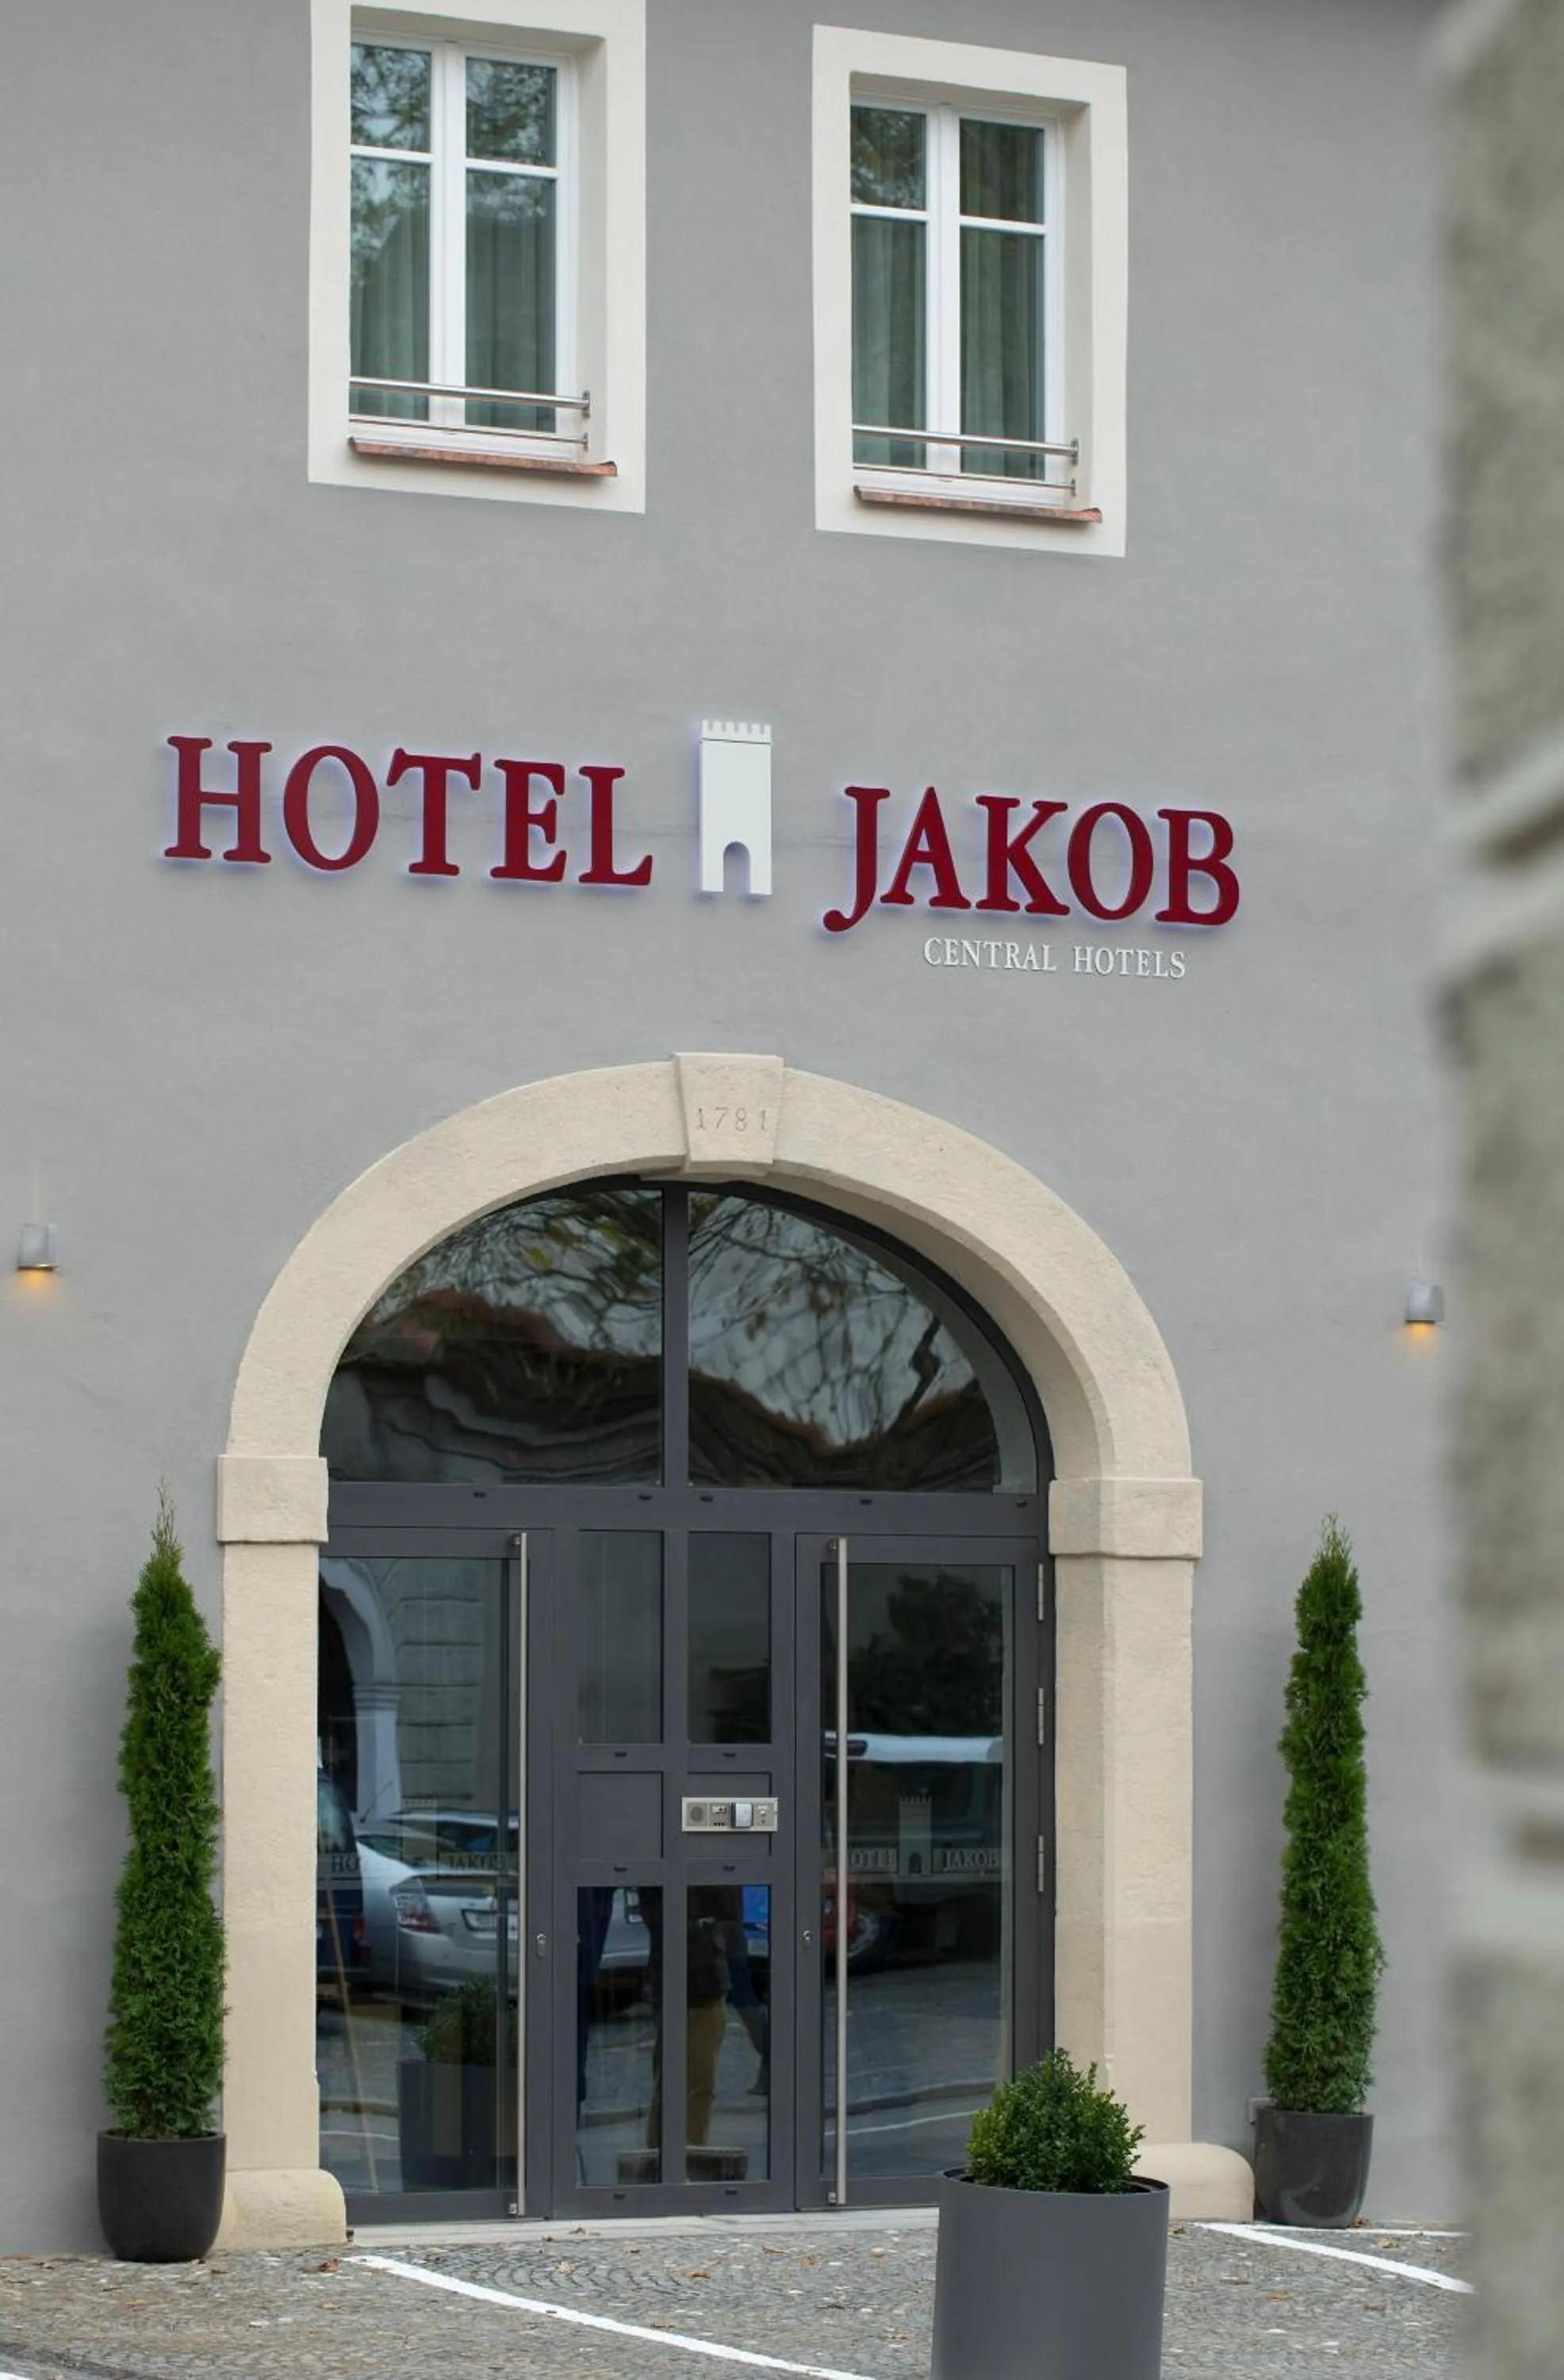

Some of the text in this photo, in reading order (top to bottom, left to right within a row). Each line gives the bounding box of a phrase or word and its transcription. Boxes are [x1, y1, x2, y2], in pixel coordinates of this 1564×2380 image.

[164, 735, 1240, 932] HOTEL JAKOB
[924, 937, 1186, 979] CENTRAL HOTELS
[697, 1107, 766, 1132] 1781
